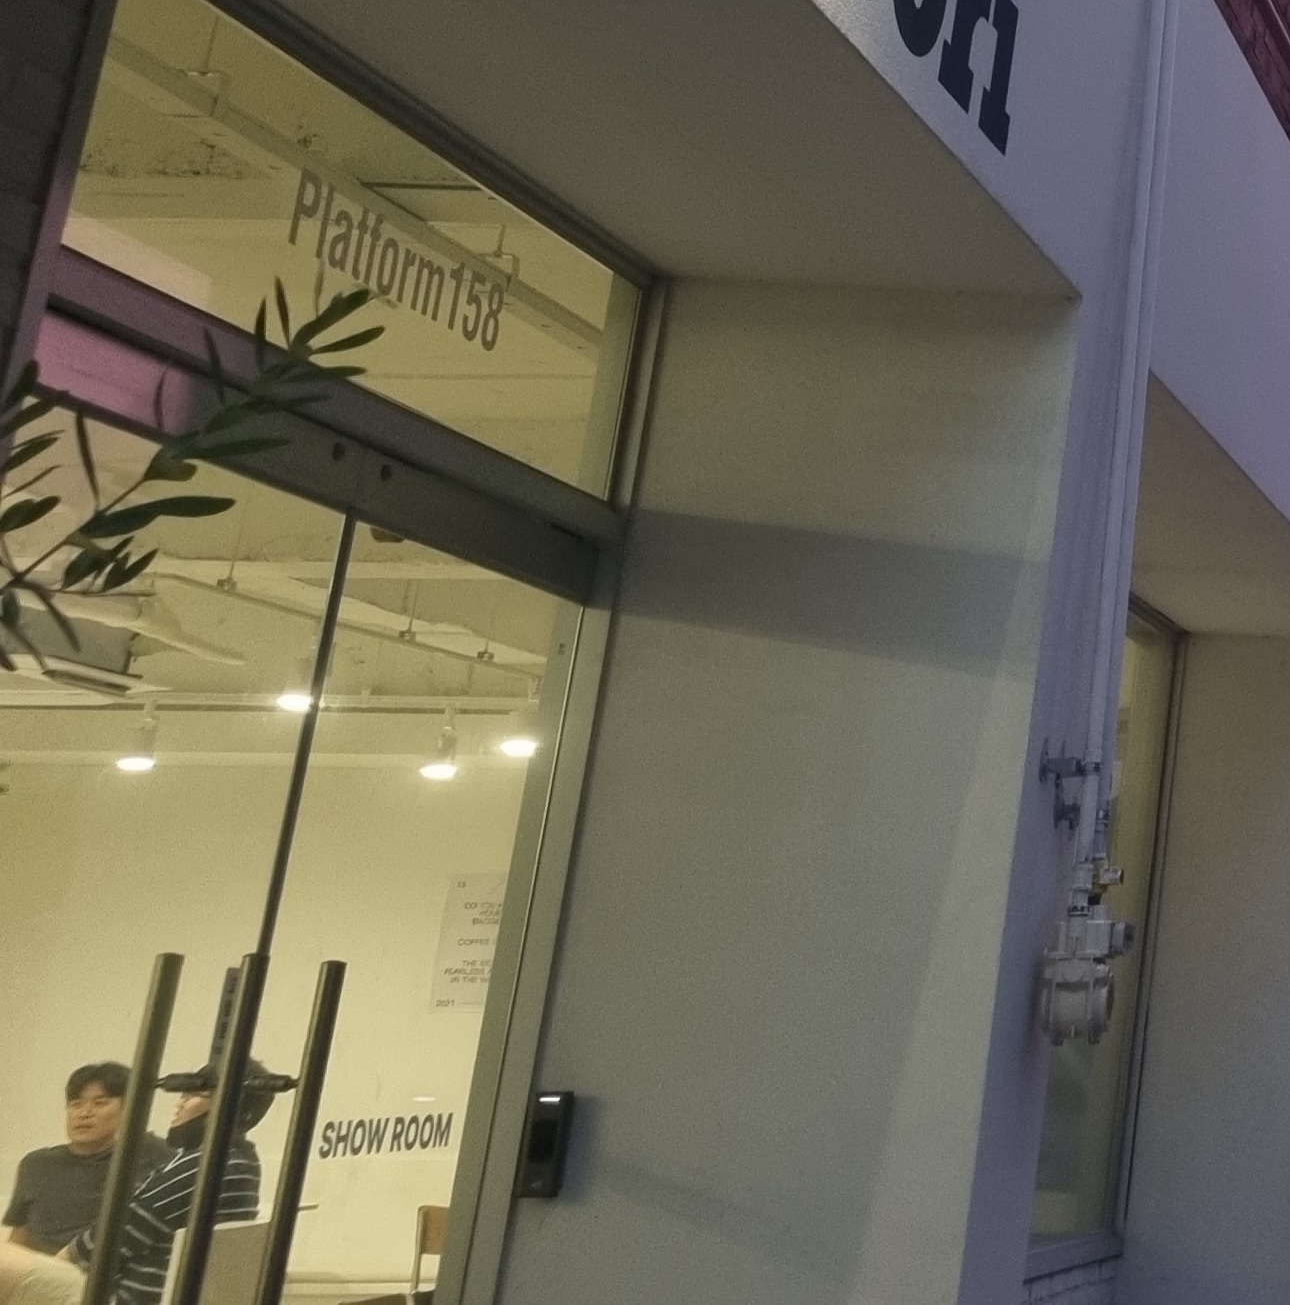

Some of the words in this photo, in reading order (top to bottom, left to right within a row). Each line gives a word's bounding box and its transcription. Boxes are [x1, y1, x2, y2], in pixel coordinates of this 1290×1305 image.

[288, 167, 505, 353] Platform158
[318, 1116, 392, 1160] SHOW
[388, 1111, 454, 1153] ROOM
